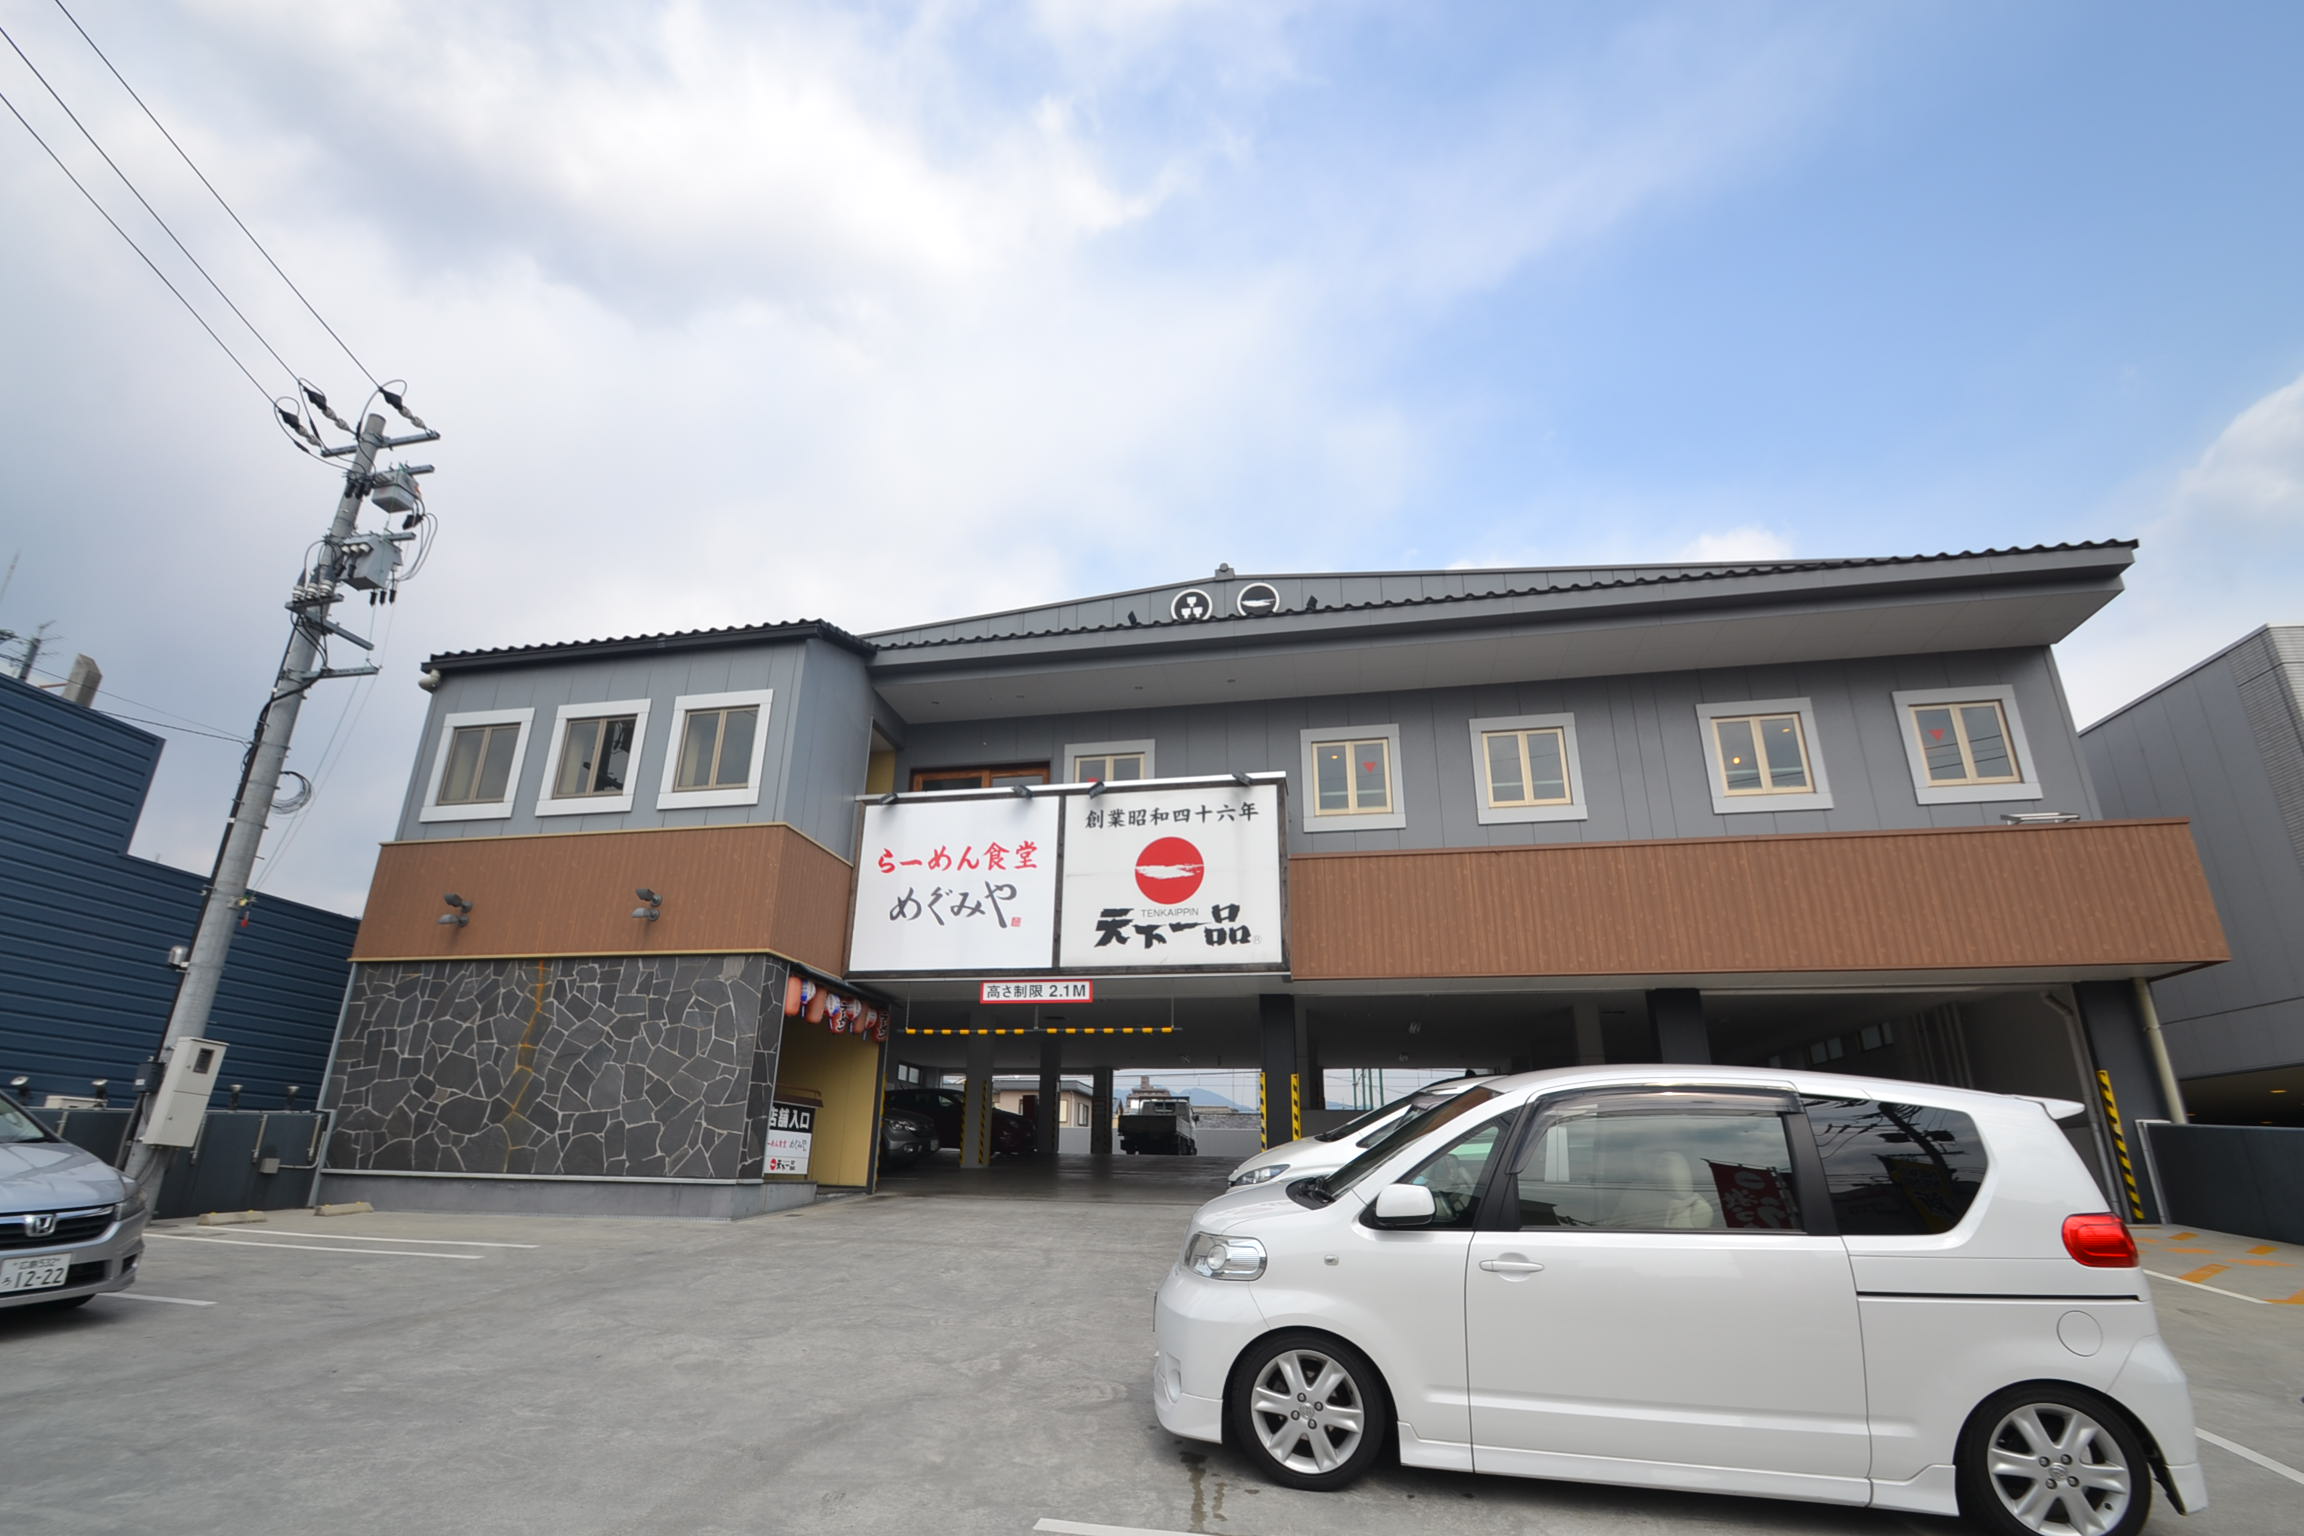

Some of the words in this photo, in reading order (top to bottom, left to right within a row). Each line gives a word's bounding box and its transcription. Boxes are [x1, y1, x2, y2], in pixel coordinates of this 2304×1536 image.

[1085, 801, 1259, 829] 創業昭和四十六年
[878, 840, 1038, 874] らーめん食堂
[889, 880, 1017, 928] めぐみや
[1141, 907, 1200, 918] TENKAIPPIN
[1094, 903, 1252, 949] 天下一品
[987, 985, 1043, 998] 高さ制限
[1049, 984, 1086, 997] 2.1M
[15, 1267, 65, 1288] 12-22
